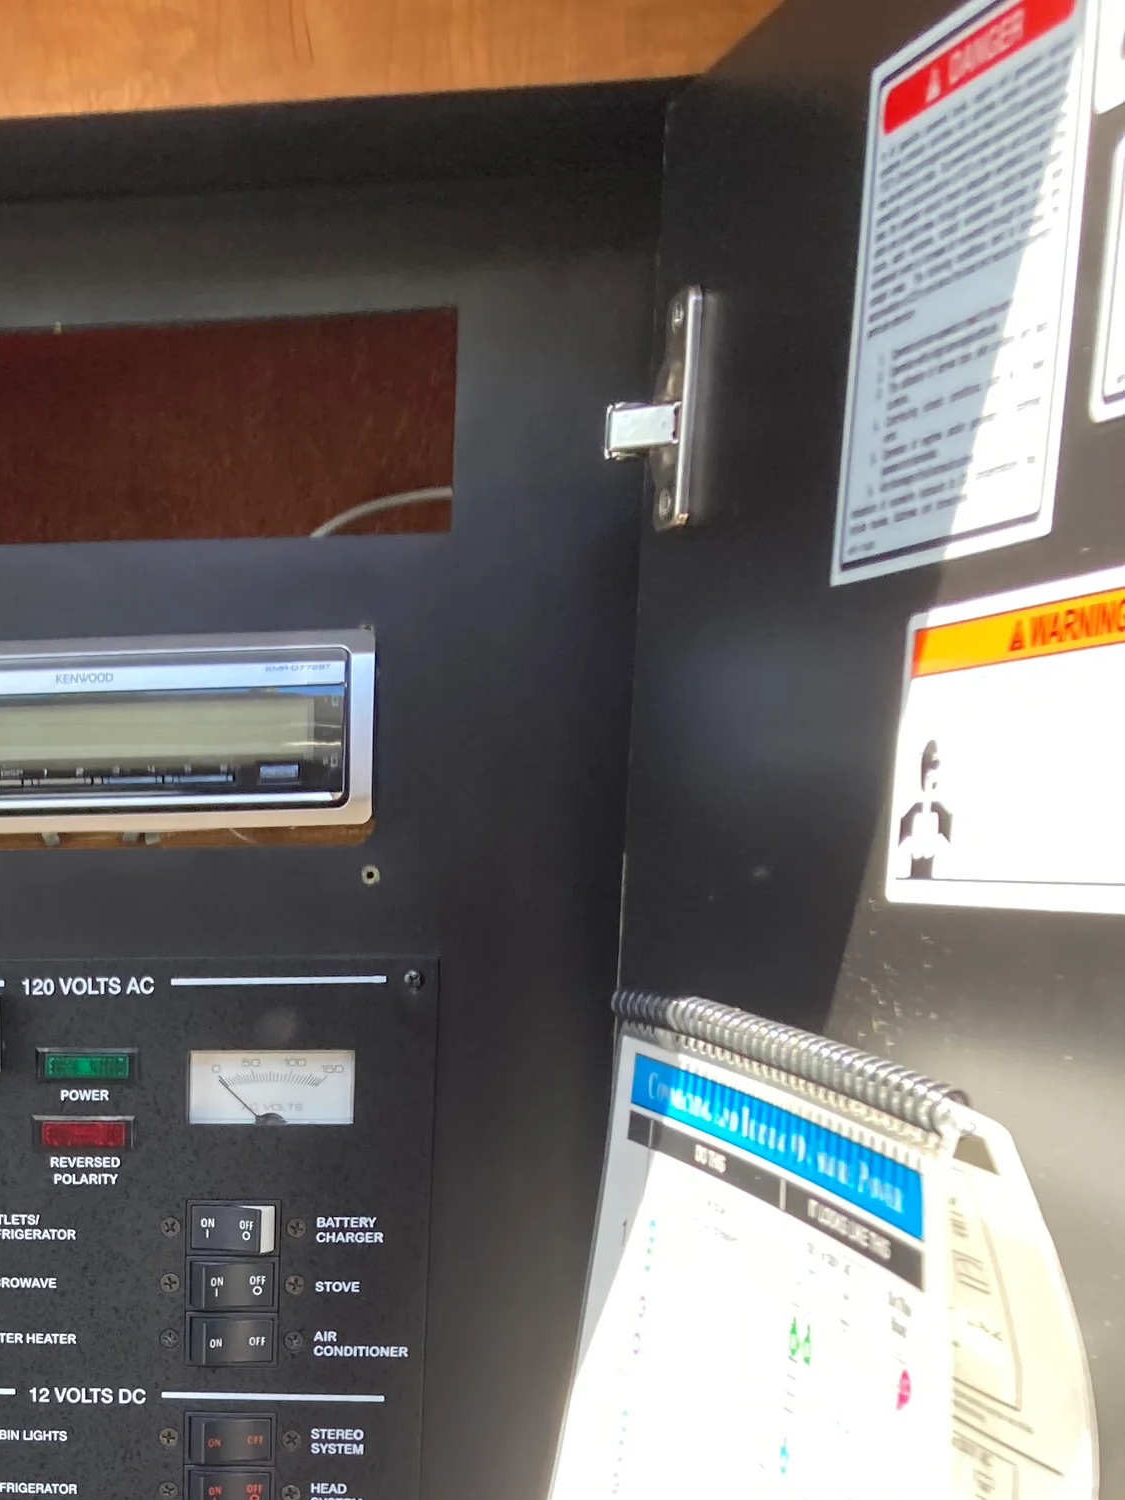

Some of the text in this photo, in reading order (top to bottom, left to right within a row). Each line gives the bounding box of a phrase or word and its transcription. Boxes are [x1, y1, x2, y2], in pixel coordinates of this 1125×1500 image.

[948, 8, 1024, 84] DANGER
[56, 673, 114, 685] KENWOOD
[22, 977, 154, 995] 120 VOLTS AC
[241, 1058, 307, 1068] 50 100
[211, 1064, 344, 1074] 0 150
[61, 1090, 109, 1101] POWER
[263, 1103, 303, 1112] VOLTS
[50, 1157, 120, 1168] REVERSED
[54, 1174, 118, 1184] POLARITY
[201, 1218, 253, 1230] ON OFF
[317, 1217, 376, 1228] BATTERY
[316, 1232, 383, 1243] CHARGER
[211, 1276, 265, 1286] ON OFF
[315, 1281, 359, 1292] STOVE
[26, 1333, 76, 1344] HEATER
[314, 1331, 337, 1341] AIR
[210, 1337, 265, 1348] ON OFF
[314, 1345, 408, 1357] CONDITIONER
[29, 1387, 146, 1404] 12 VOLTS DC
[23, 1430, 67, 1441] LIGHTS
[311, 1429, 363, 1440] STEREO
[208, 1436, 263, 1448] ON OFF
[311, 1443, 364, 1454] SYSTEM
[209, 1484, 262, 1496] ON OFF
[311, 1483, 347, 1494] HEAD
